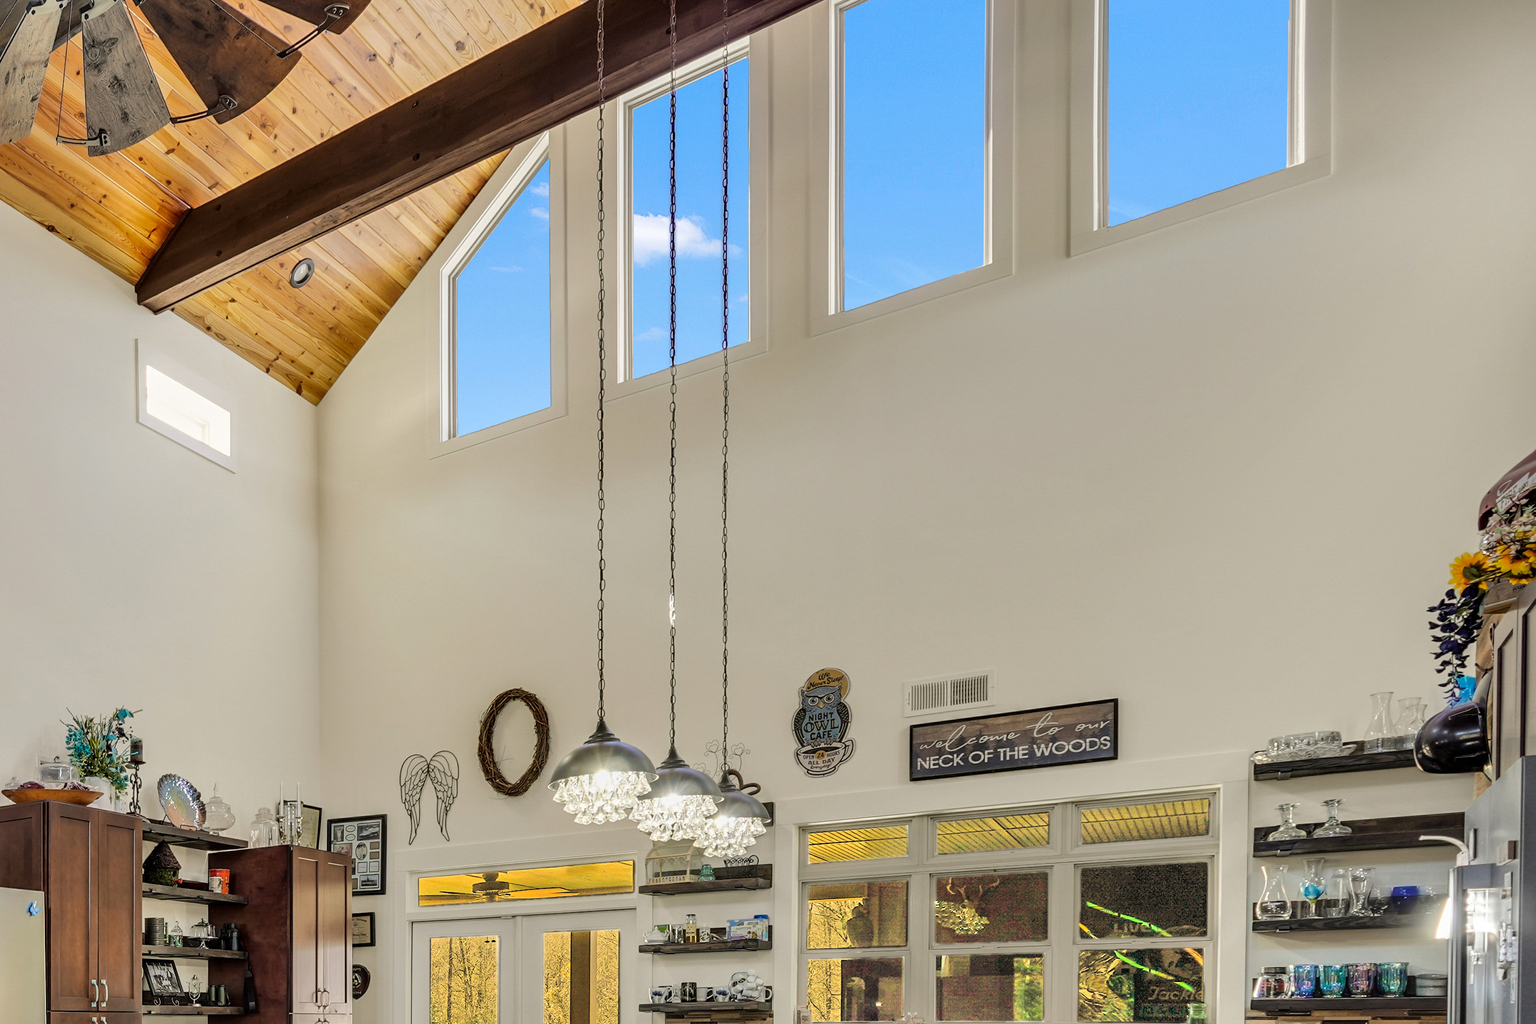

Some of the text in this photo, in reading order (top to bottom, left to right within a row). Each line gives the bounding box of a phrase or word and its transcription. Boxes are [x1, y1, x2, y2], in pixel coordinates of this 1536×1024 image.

[809, 712, 834, 721] NIGHT
[803, 719, 839, 733] OWL
[919, 712, 1111, 752] welcome to our
[810, 730, 832, 740] CAFE
[917, 736, 1111, 771] NECK OF THE WOODS
